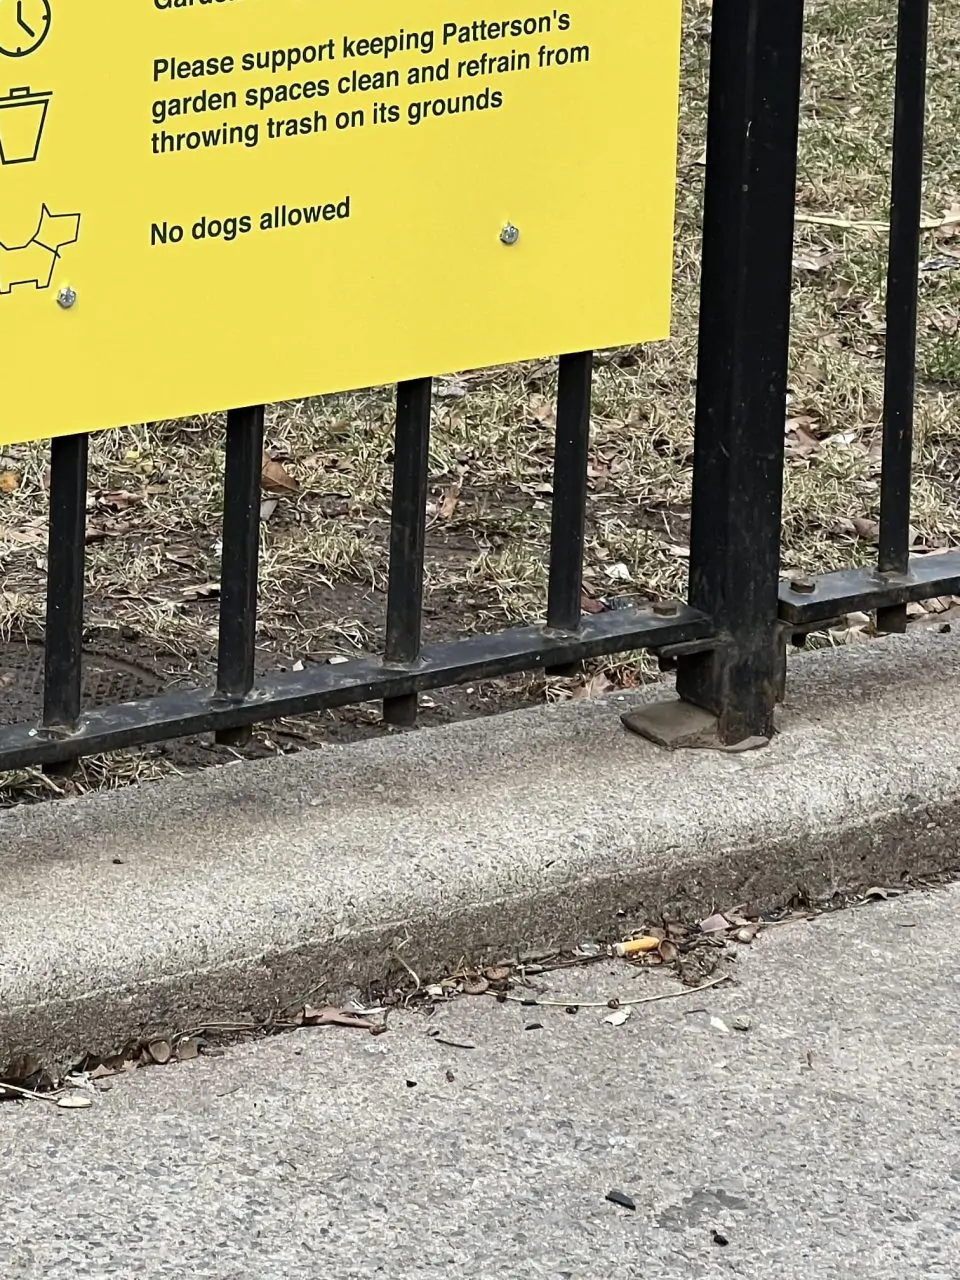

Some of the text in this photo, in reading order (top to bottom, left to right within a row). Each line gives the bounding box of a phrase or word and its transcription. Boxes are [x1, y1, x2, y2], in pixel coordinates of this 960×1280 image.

[153, 9, 570, 82] Please support keeping Patterson's
[152, 45, 590, 125] garden spaces clean and refrain from
[150, 87, 503, 154] throwing trash on its grounds
[151, 195, 350, 246] No dogs allowed
